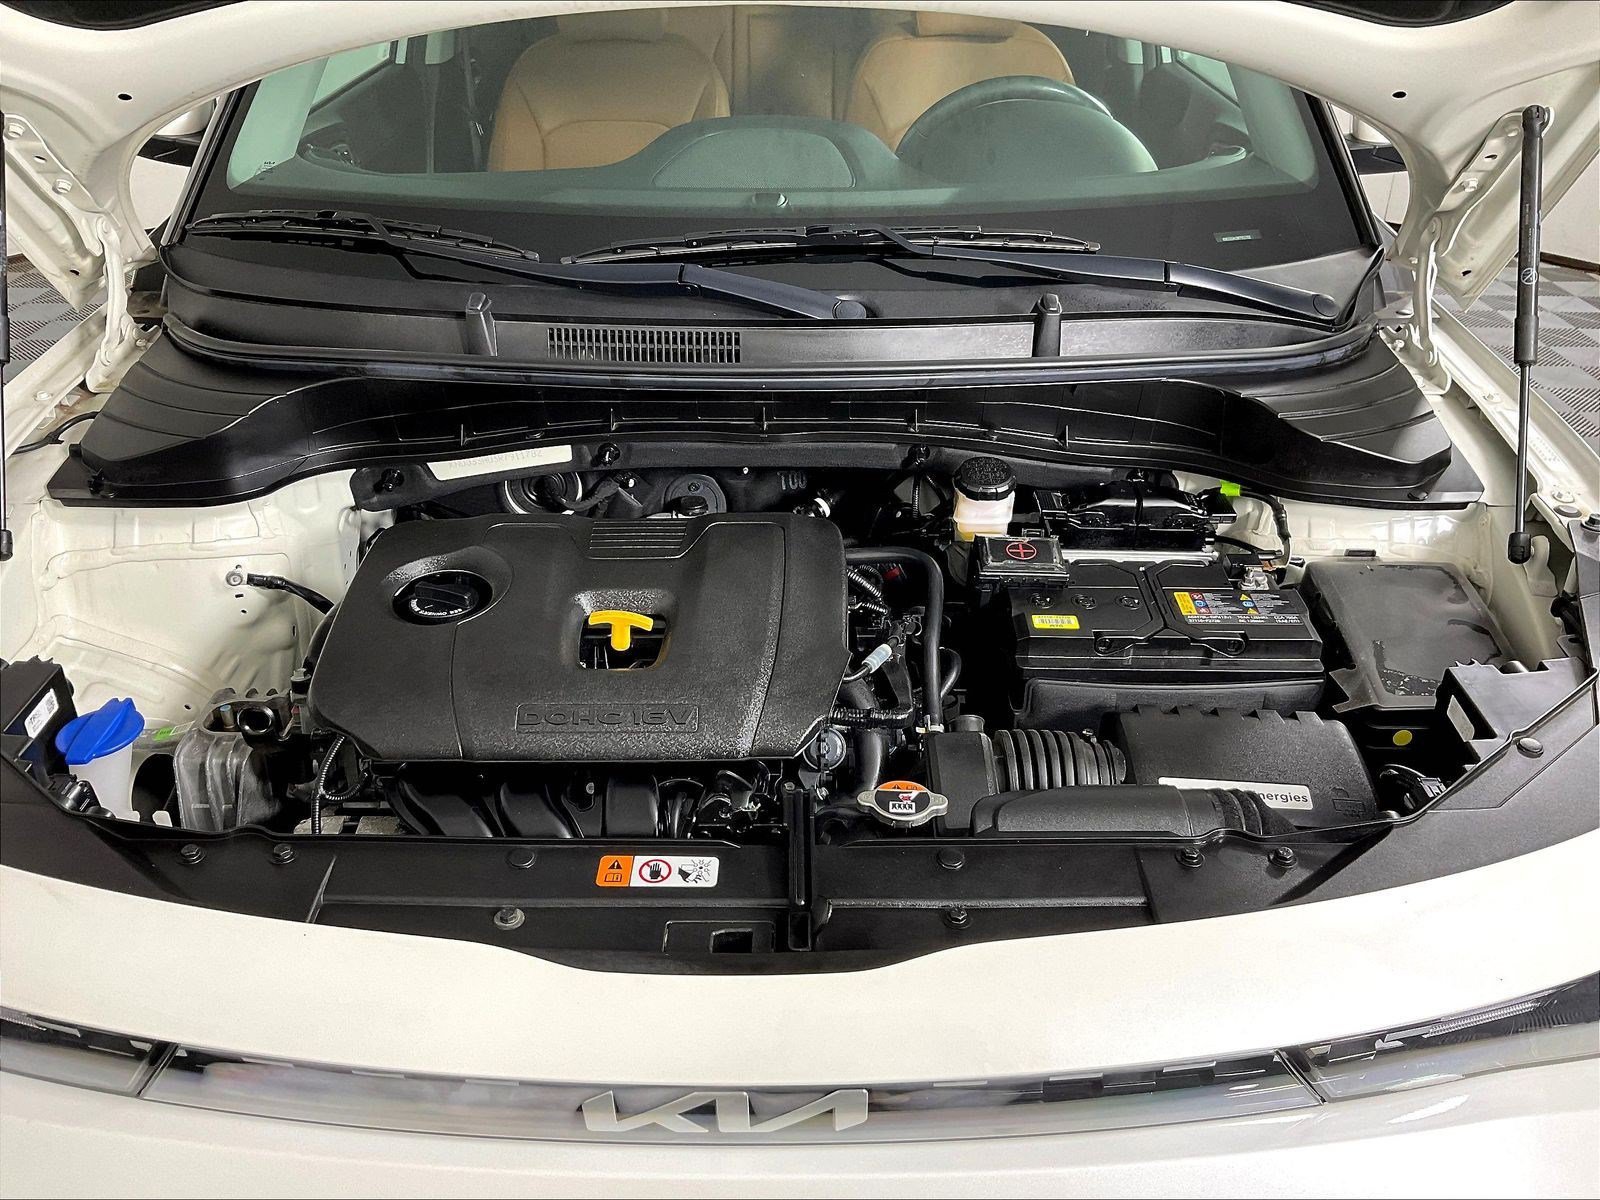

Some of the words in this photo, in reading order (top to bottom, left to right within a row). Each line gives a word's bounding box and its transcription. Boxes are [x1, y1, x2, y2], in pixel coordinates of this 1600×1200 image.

[518, 709, 623, 726] DOHC
[632, 708, 695, 726] 16V
[1259, 792, 1308, 803] nergies
[581, 1088, 869, 1133] KIA
